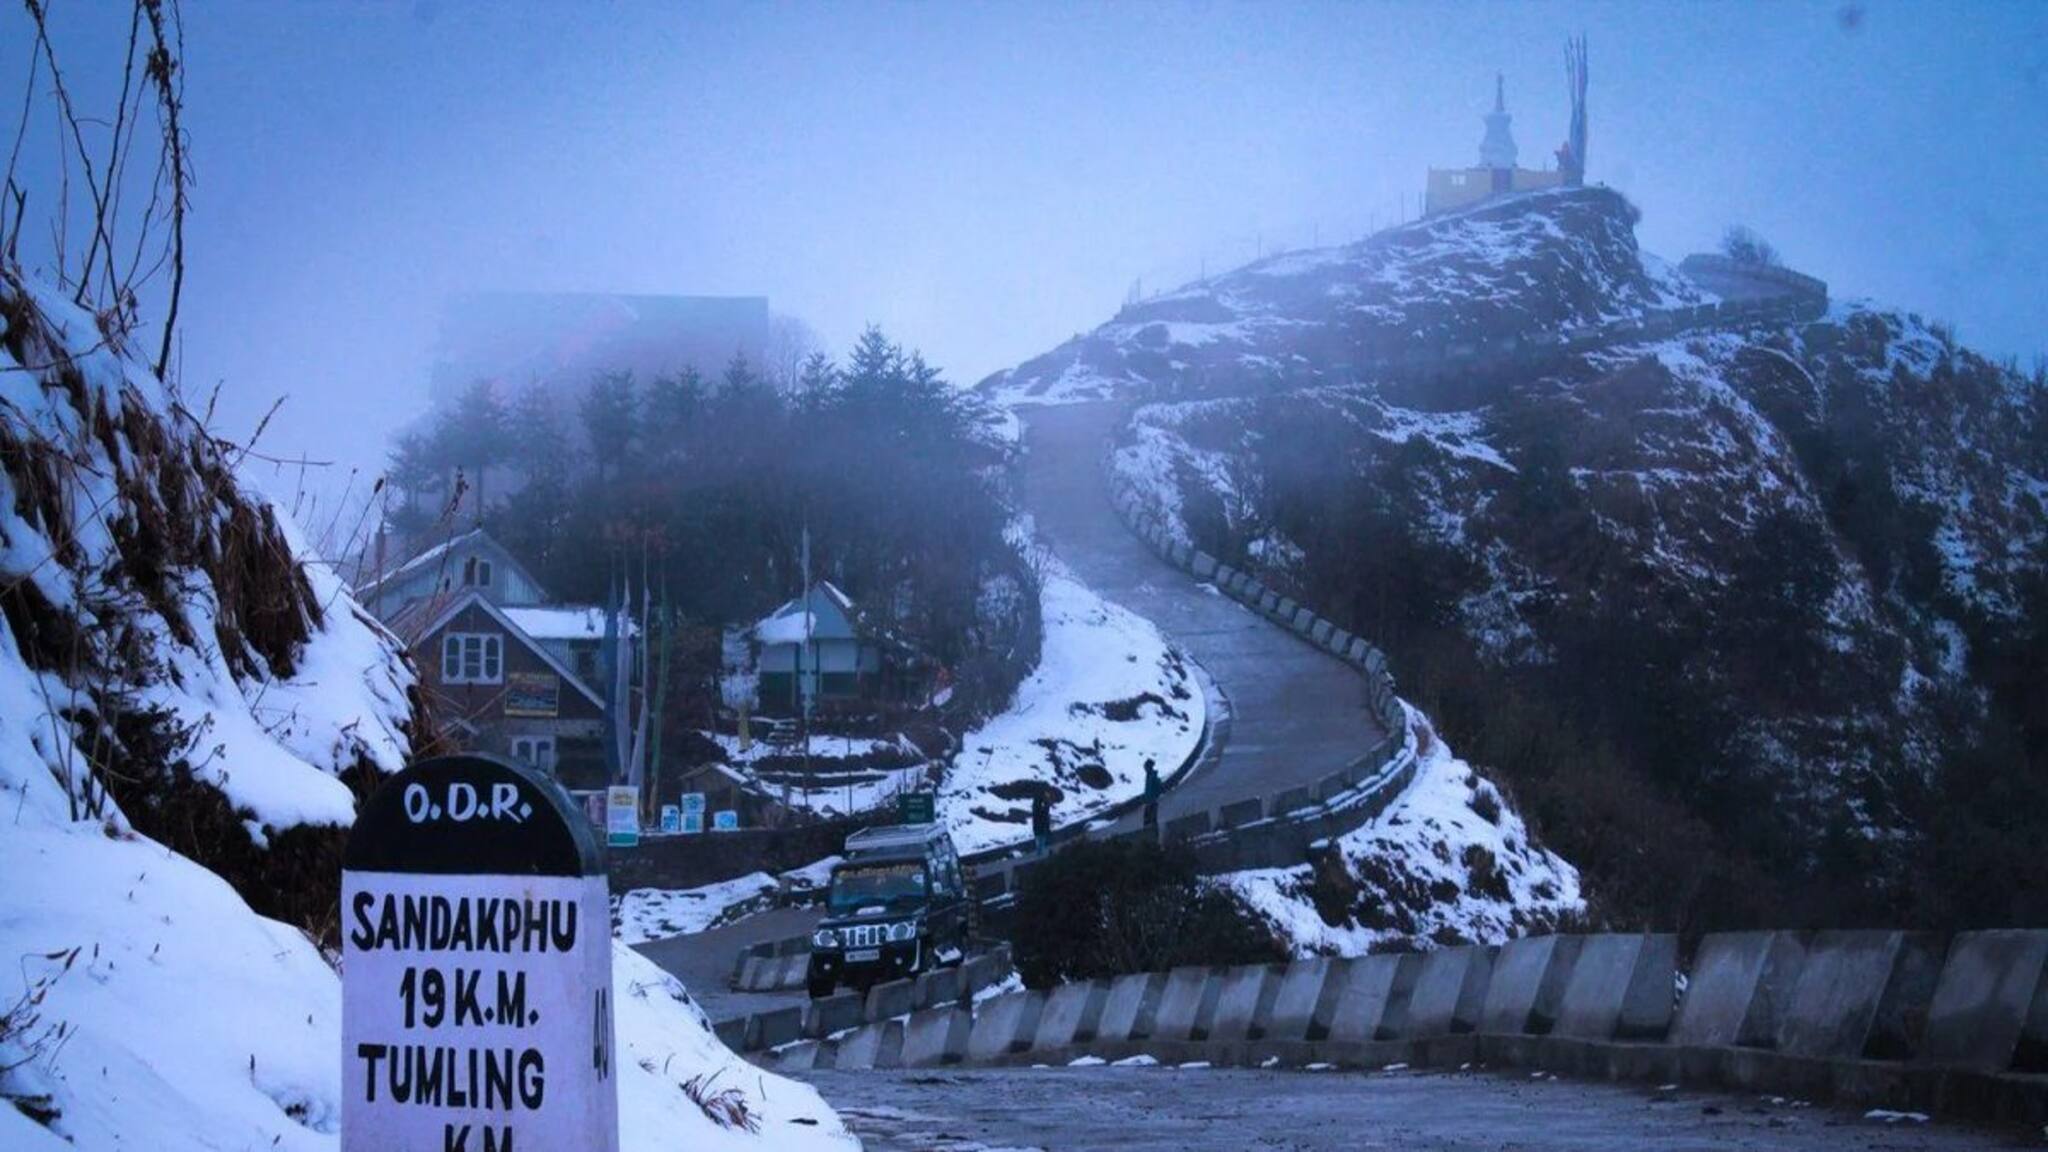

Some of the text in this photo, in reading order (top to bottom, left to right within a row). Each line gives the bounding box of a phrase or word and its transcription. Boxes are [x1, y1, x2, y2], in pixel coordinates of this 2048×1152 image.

[405, 784, 532, 823] O.D.R.
[351, 890, 577, 954] SANDAKPHU
[357, 1043, 545, 1111] TUMLING
